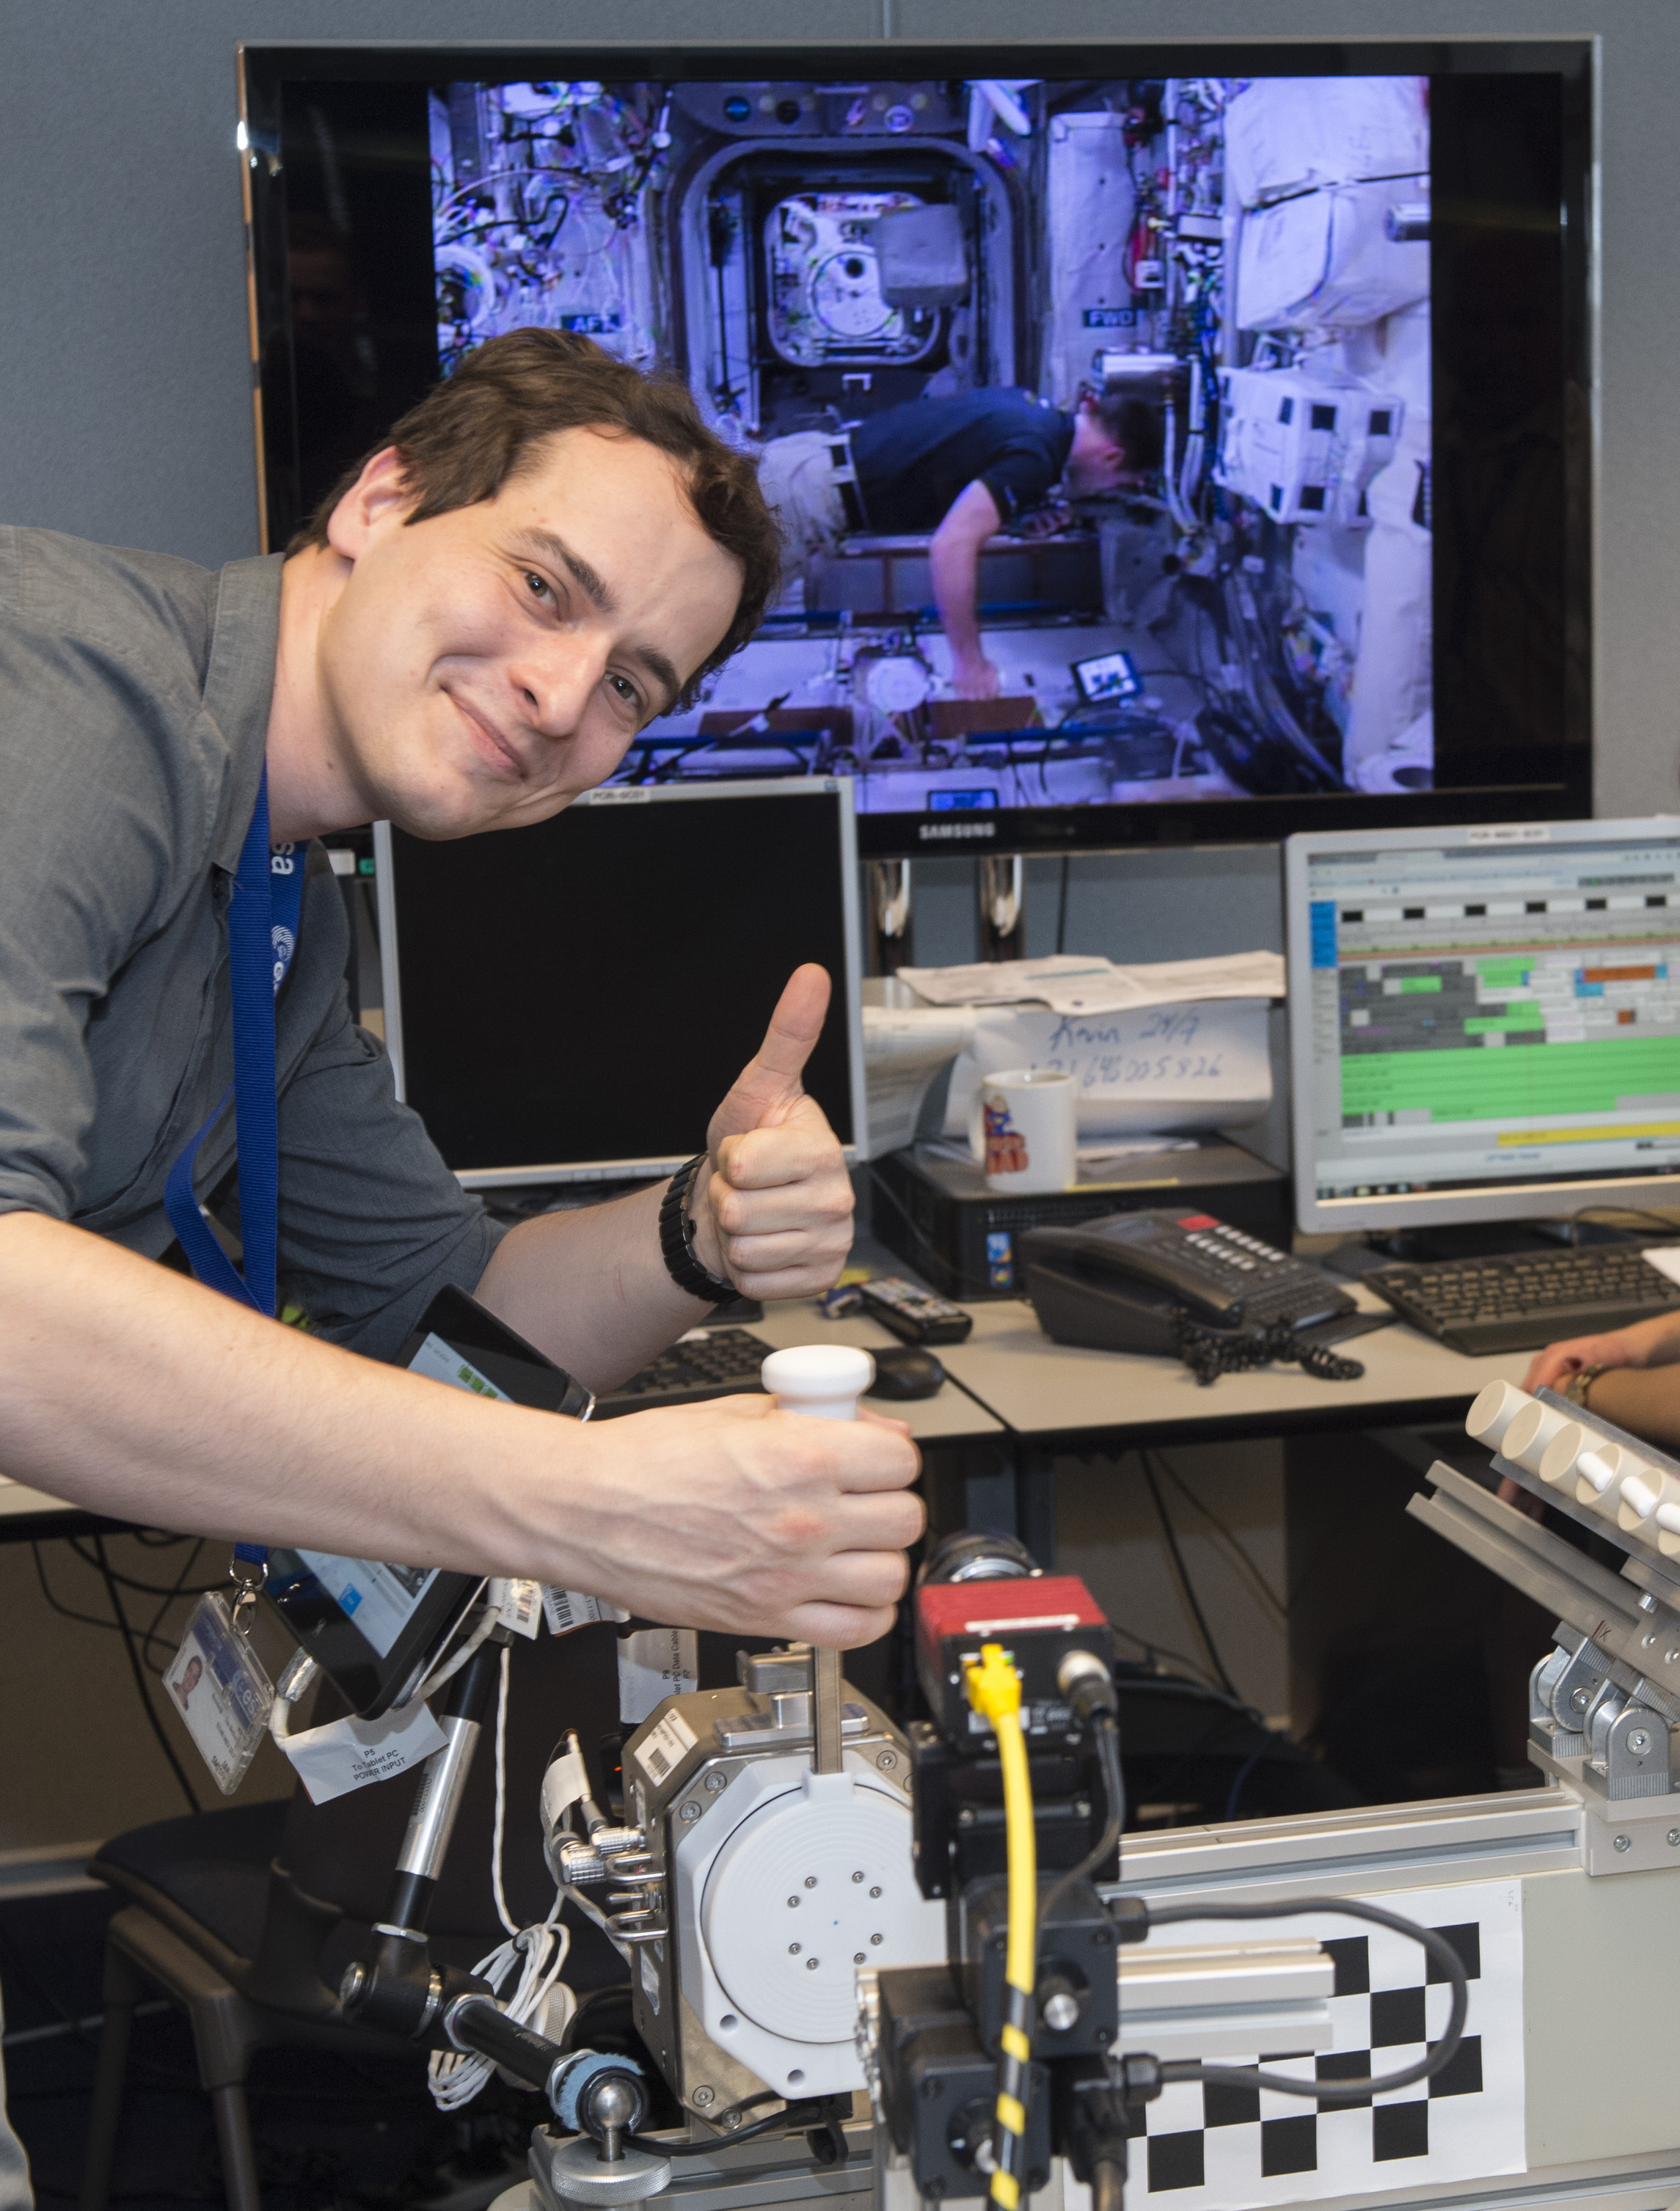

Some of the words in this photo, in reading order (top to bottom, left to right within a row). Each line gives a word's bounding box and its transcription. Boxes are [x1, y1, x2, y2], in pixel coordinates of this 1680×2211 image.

[919, 822, 996, 840] SAMSUNG
[671, 1630, 679, 1651] Cable
[671, 1653, 680, 1669] Data
[662, 1670, 670, 1680] P9
[672, 1671, 680, 1682] PC
[351, 1764, 362, 1772] To
[362, 1755, 387, 1769] Tablet
[386, 1750, 399, 1760] PC
[364, 1749, 375, 1758] P5
[354, 1768, 381, 1780] POWER
[381, 1757, 406, 1772] INPUT
